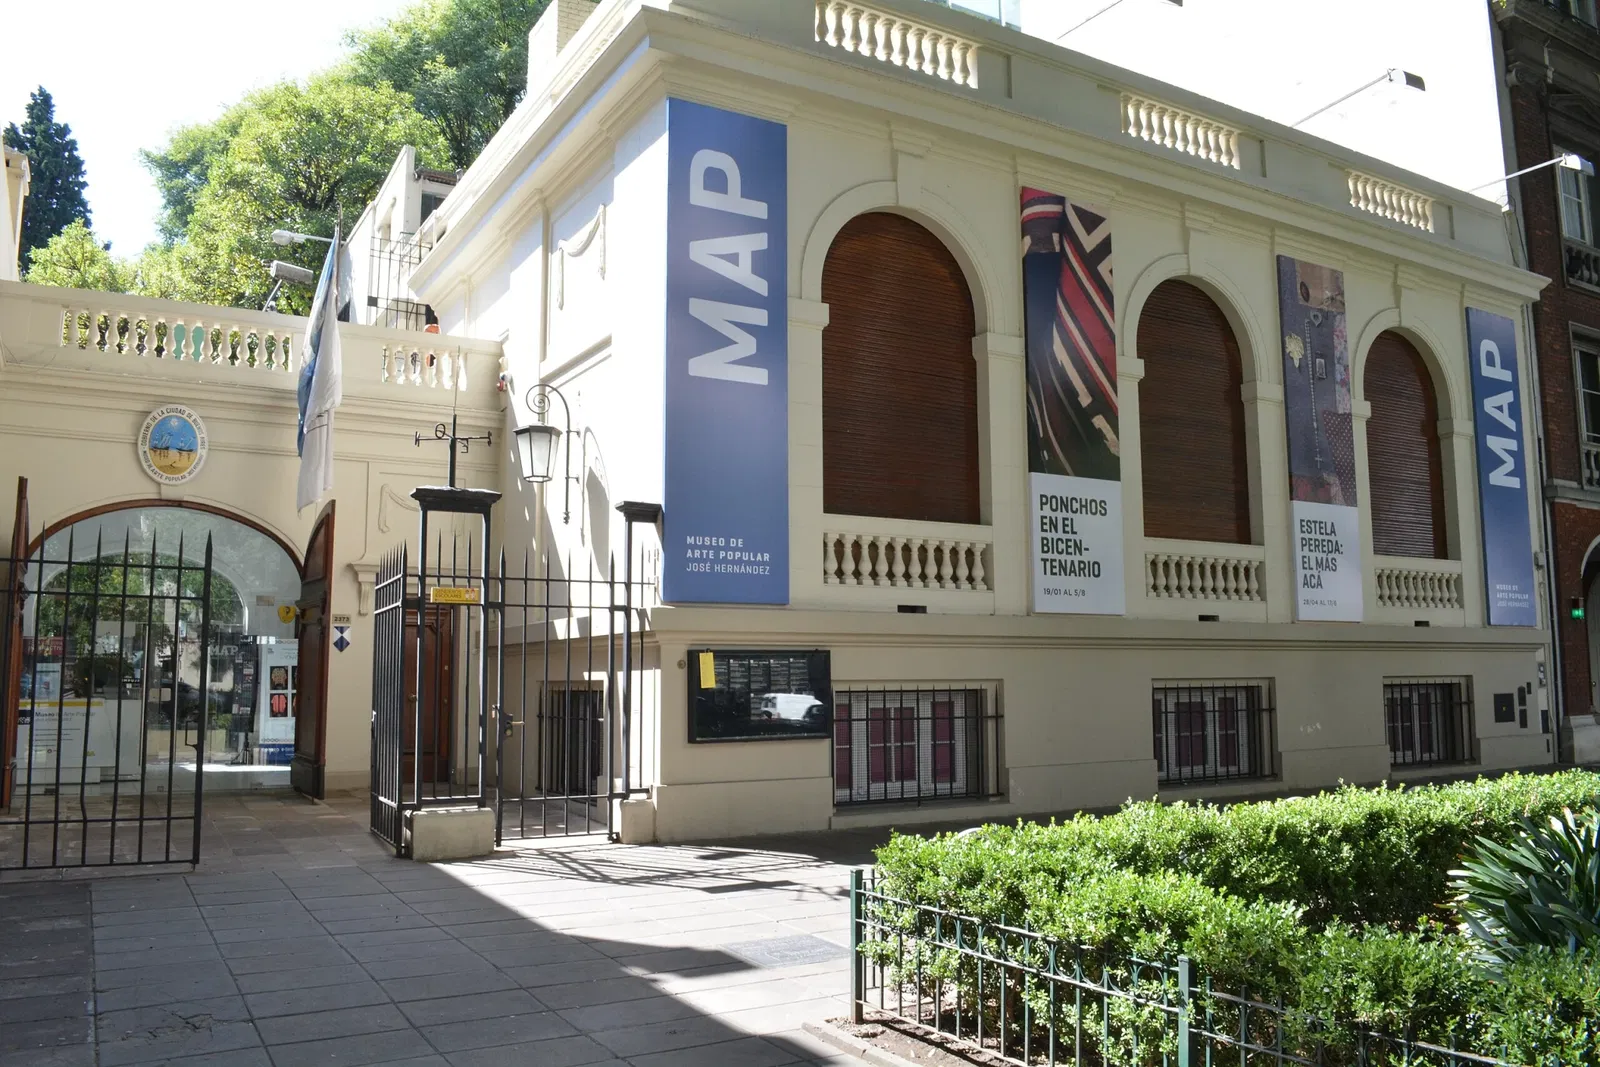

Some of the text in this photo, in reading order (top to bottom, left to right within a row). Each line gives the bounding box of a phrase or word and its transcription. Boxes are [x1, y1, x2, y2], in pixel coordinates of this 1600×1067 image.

[688, 148, 769, 386] MAP
[166, 408, 186, 416] CIUDAD
[1479, 338, 1521, 489] MAP
[1039, 493, 1108, 516] PONCHOS
[1040, 515, 1078, 535] EN EL
[1300, 518, 1337, 536] ESTELA
[686, 535, 744, 548] MUSEO DE
[1040, 536, 1090, 556] BICEN-
[1300, 537, 1344, 555] PEREDA:
[686, 549, 770, 562] ARTE POPULAR
[1302, 553, 1338, 572] EL MÁS
[686, 562, 770, 575] JOSÉ HERNÁNDEZ
[1040, 558, 1101, 578] TENARIO
[1302, 570, 1324, 590] ACÁ
[1043, 587, 1062, 596] 19/01
[1074, 589, 1086, 598] 5/8
[210, 645, 238, 656] MAP
